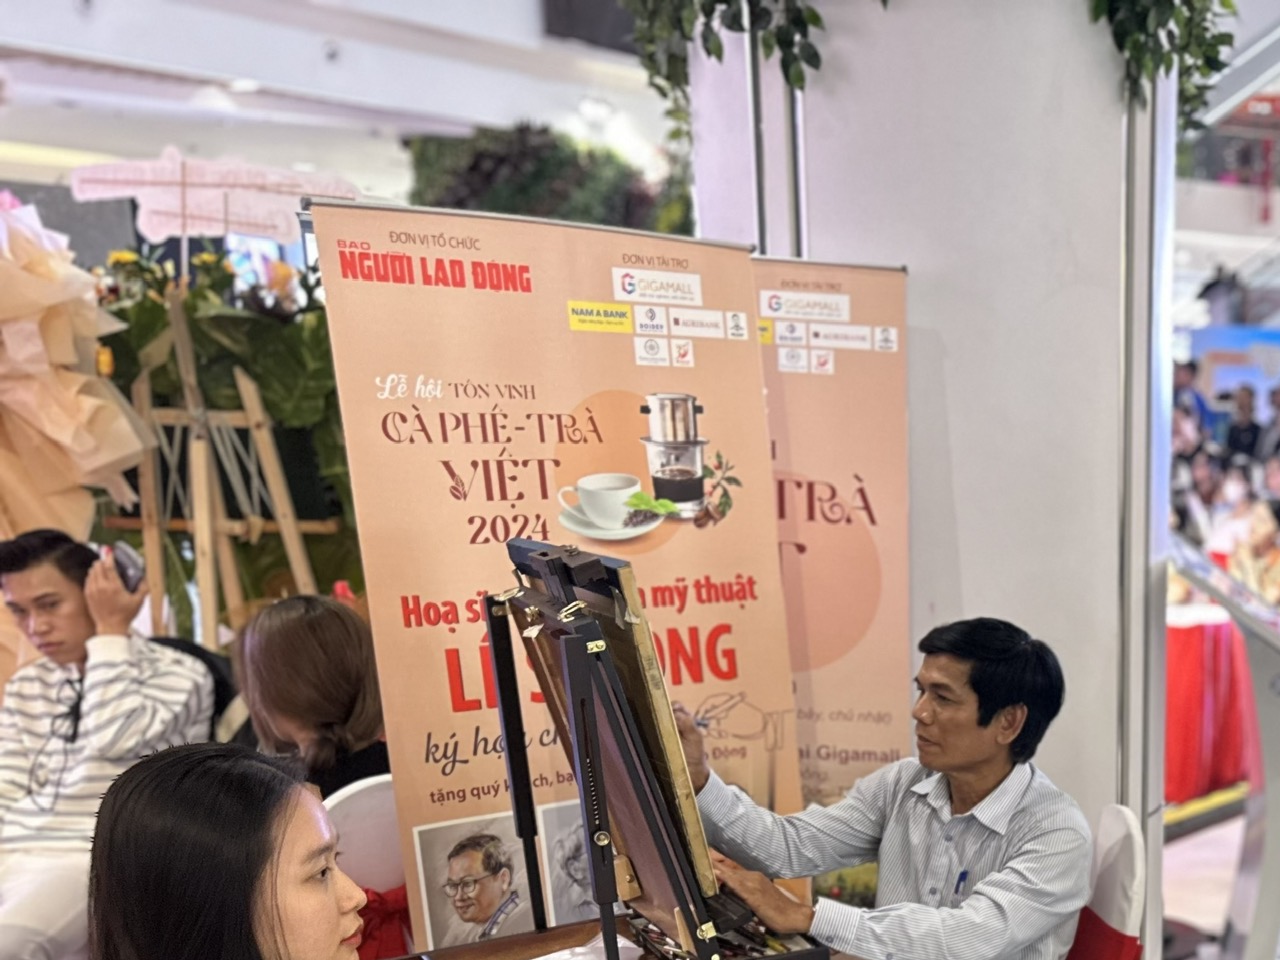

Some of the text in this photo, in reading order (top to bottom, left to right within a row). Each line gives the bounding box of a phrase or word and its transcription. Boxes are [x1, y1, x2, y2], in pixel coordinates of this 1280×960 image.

[389, 231, 418, 245] ĐƠN
[449, 233, 482, 251] CHỨC
[419, 256, 467, 288] LAO
[638, 279, 694, 295] GIGAMALL
[571, 308, 628, 319] NAM A BANK
[375, 373, 409, 400] Lễ
[415, 374, 444, 402] hội
[495, 383, 536, 400] VINH
[381, 404, 433, 444] CÀ
[438, 446, 561, 510] VIỆT
[467, 513, 550, 545] 2024
[400, 595, 460, 633] Hoạ
[651, 577, 689, 614] mỹ
[694, 573, 758, 610] thuật
[425, 732, 469, 776] ký
[816, 744, 902, 766] Gigamall
[430, 787, 467, 806] tặng
[470, 780, 501, 800] quý
